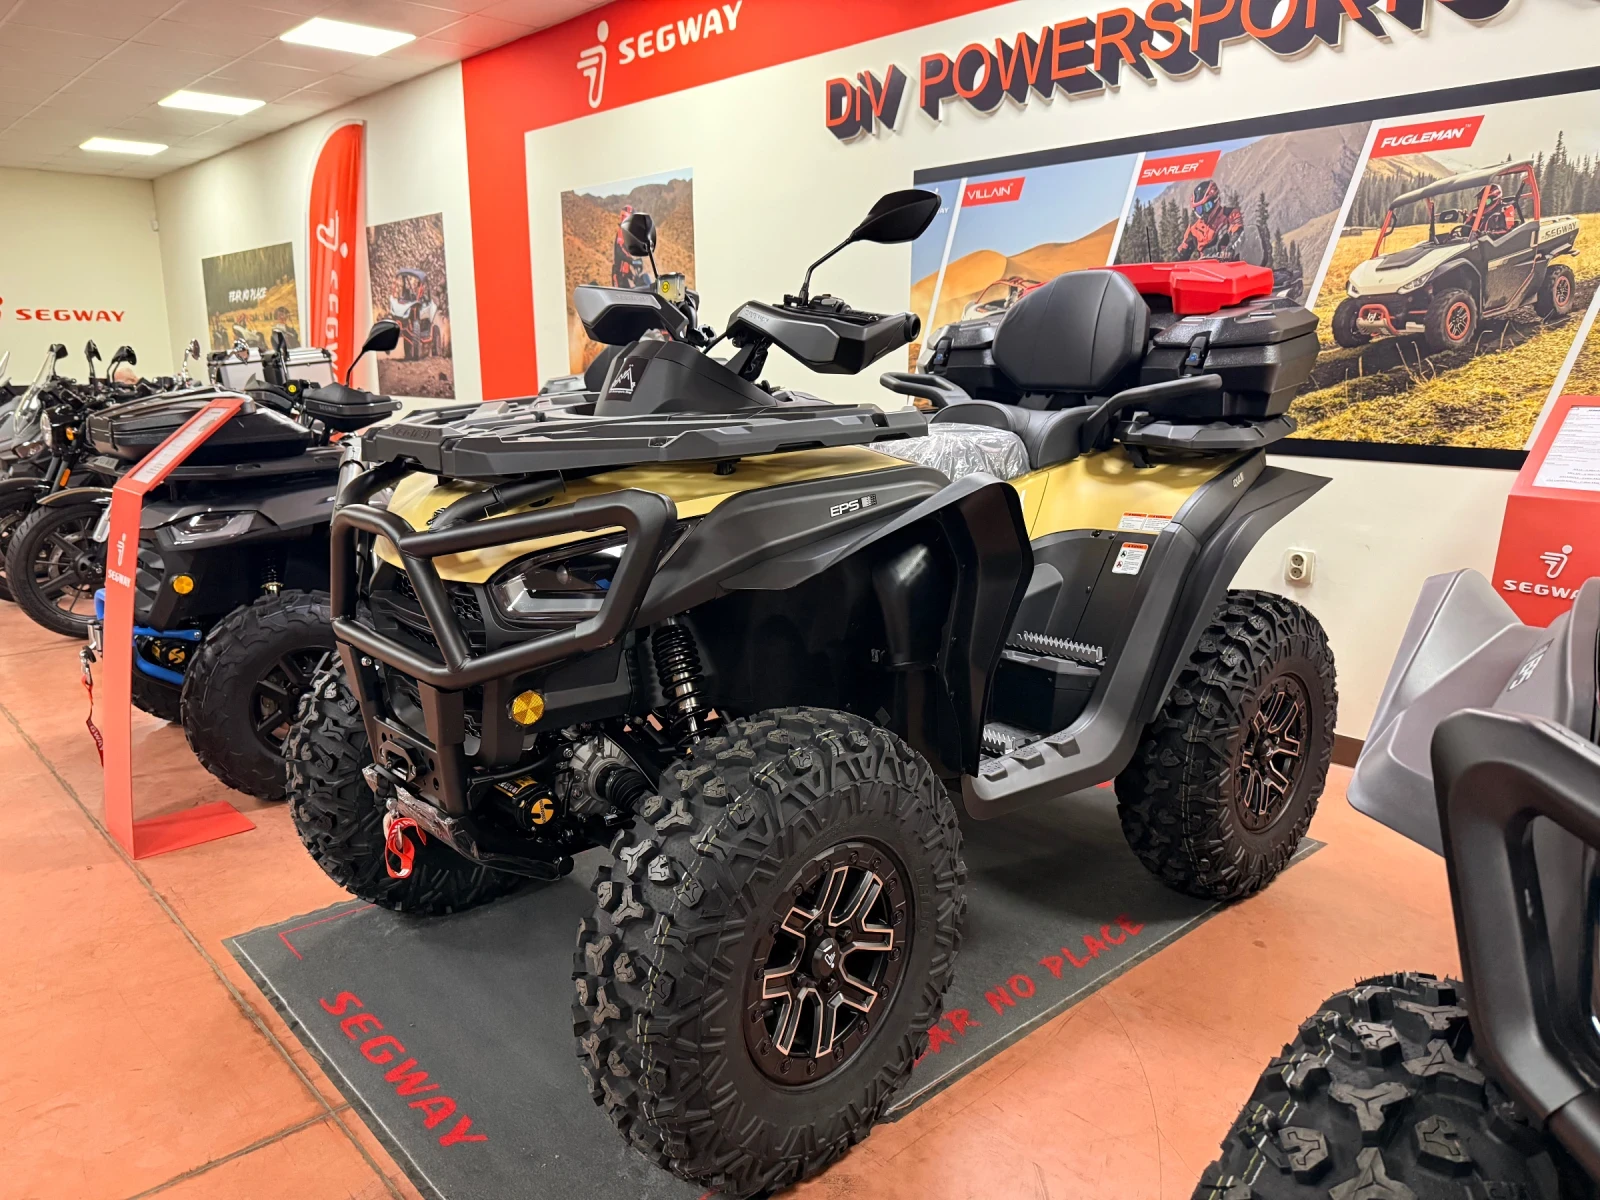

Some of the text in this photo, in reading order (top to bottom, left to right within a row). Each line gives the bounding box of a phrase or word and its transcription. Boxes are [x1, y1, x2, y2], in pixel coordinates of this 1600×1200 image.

[618, 0, 742, 65] SEGWAY
[825, 63, 903, 135] DiV
[15, 308, 125, 322] SEGWAY
[830, 499, 860, 517] EPS
[107, 569, 131, 588] SEGWAY
[984, 974, 1036, 1016] NO
[1038, 913, 1145, 980] PLACE
[318, 990, 488, 1147] SEGWAY
